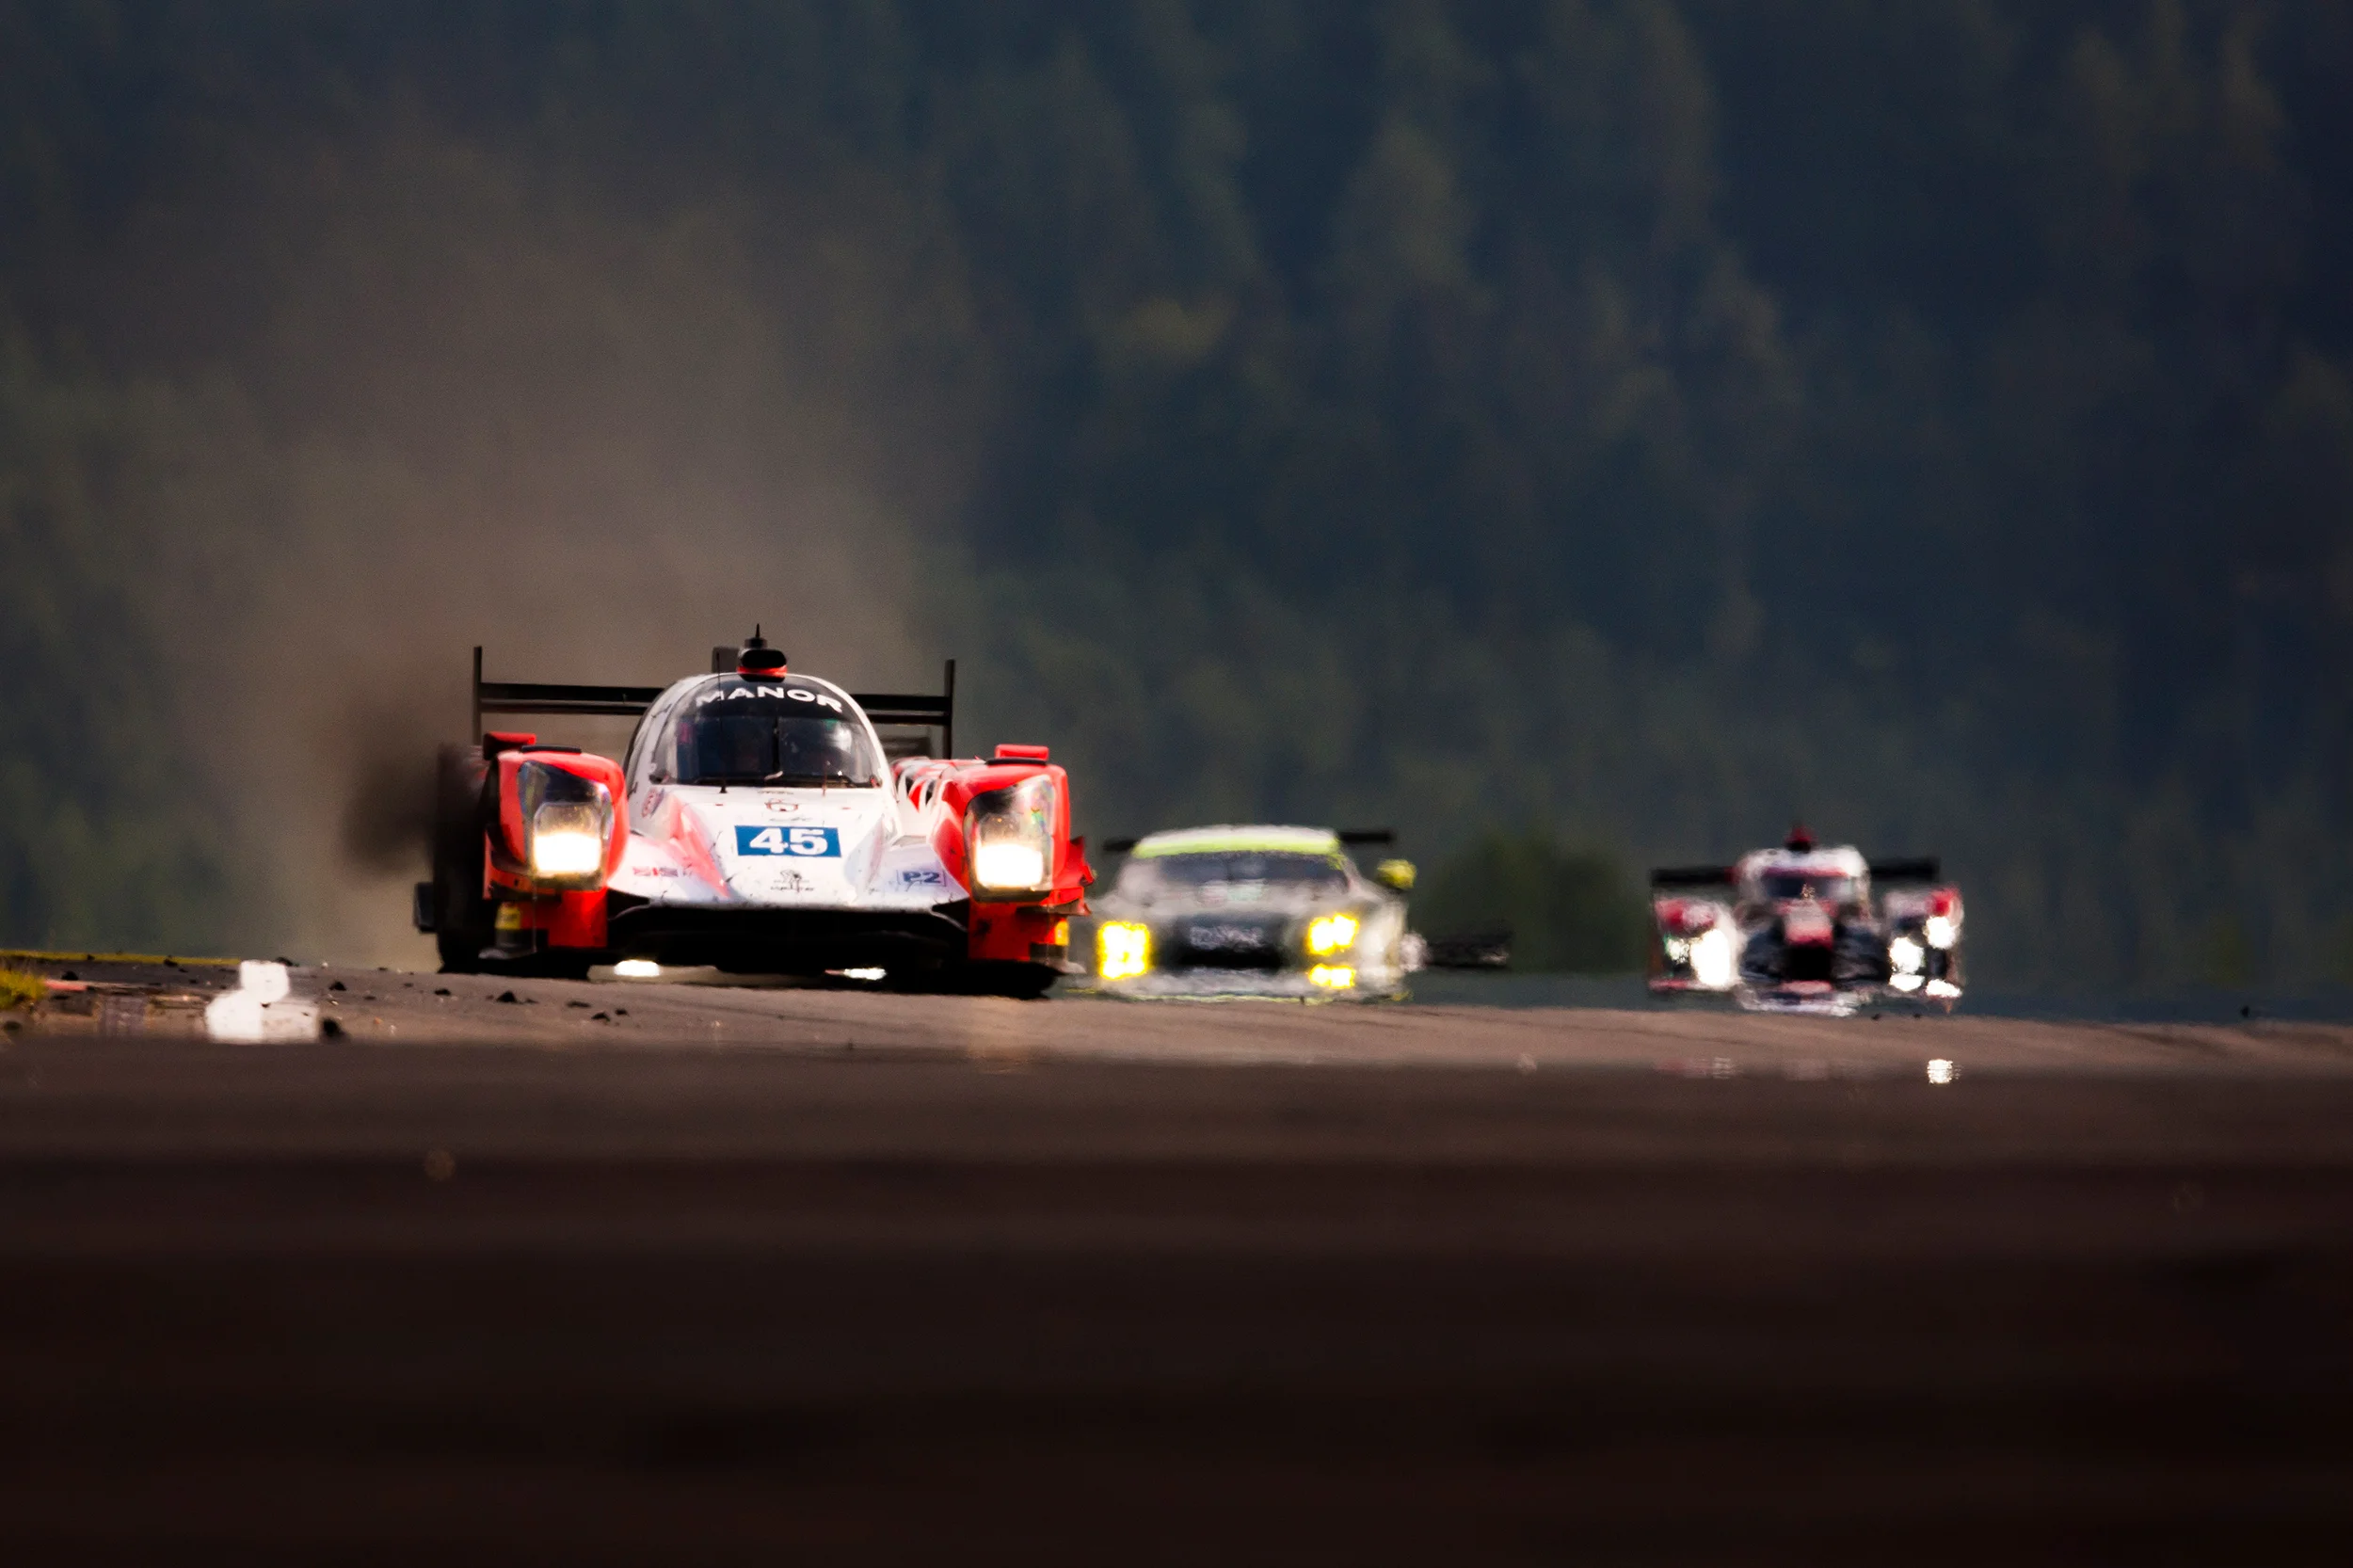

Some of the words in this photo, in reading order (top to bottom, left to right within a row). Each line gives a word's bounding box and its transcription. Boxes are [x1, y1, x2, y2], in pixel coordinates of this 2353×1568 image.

[696, 686, 842, 712] MANOR
[749, 828, 828, 855] 45
[903, 872, 940, 885] P2
